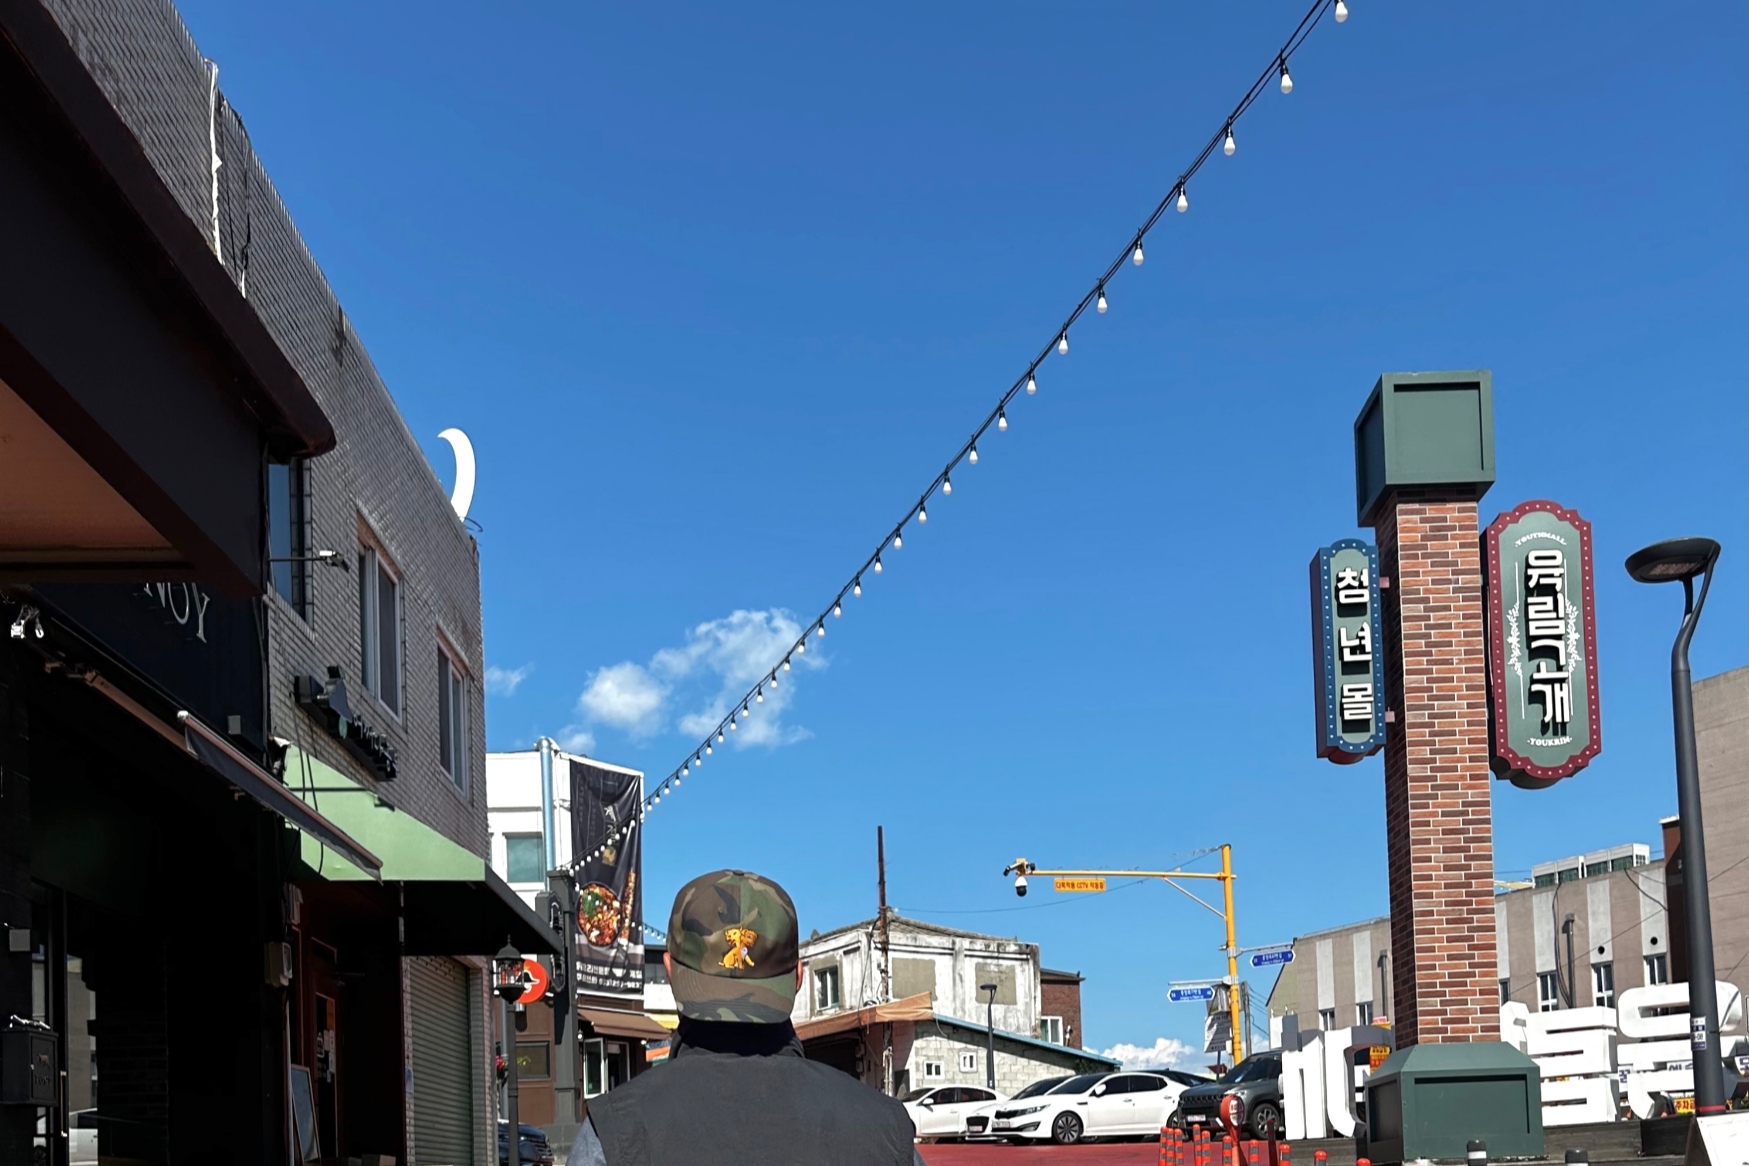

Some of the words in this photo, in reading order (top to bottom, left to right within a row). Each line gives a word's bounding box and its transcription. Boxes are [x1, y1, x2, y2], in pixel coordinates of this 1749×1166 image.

[1337, 566, 1375, 721] 청년몰
[1527, 548, 1571, 723] 육림고개
[1529, 735, 1571, 747] YOUKRIM
